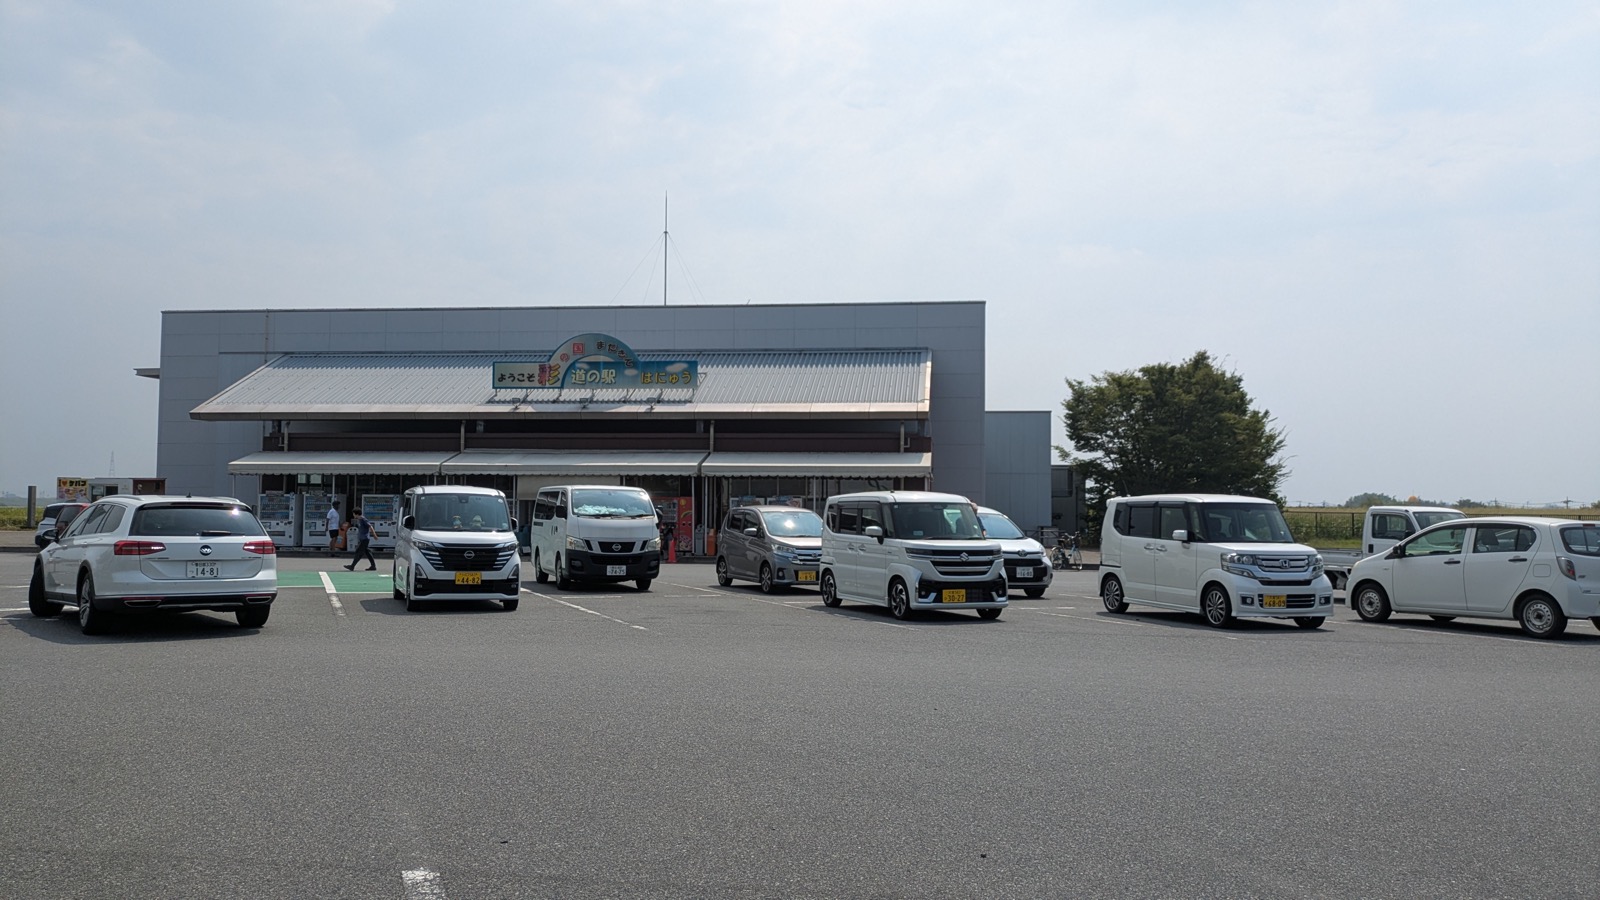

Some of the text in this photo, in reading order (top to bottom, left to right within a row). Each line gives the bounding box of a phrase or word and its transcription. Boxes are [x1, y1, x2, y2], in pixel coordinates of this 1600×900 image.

[497, 373, 535, 382] ようこそ
[571, 369, 692, 384] 道の駅 はにゅう
